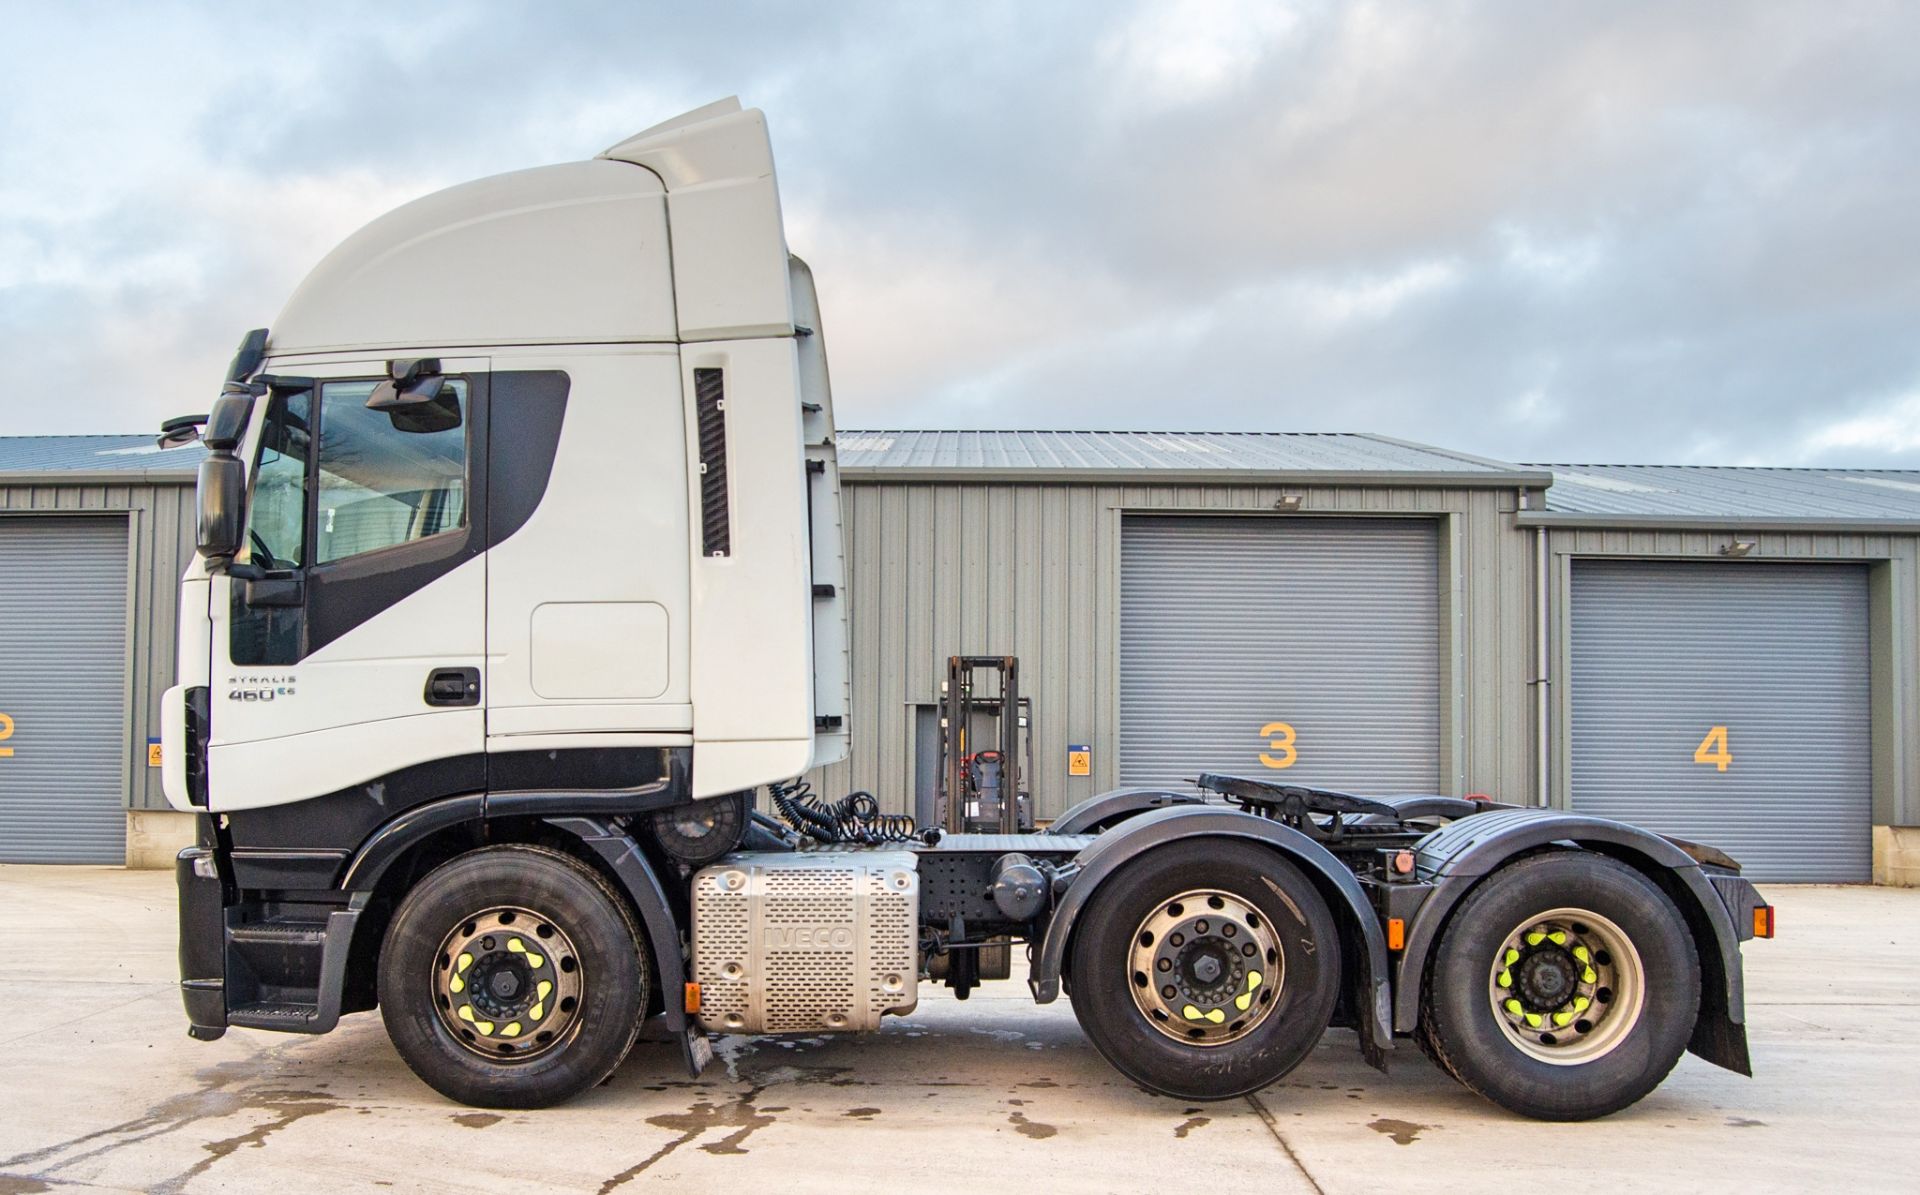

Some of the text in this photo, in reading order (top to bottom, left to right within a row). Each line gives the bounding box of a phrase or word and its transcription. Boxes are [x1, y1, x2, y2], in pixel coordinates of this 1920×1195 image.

[229, 676, 296, 684] STRALIS
[228, 688, 275, 702] 460
[1259, 722, 1297, 769] 3
[1694, 726, 1733, 772] 4
[764, 927, 853, 948] IVECO
